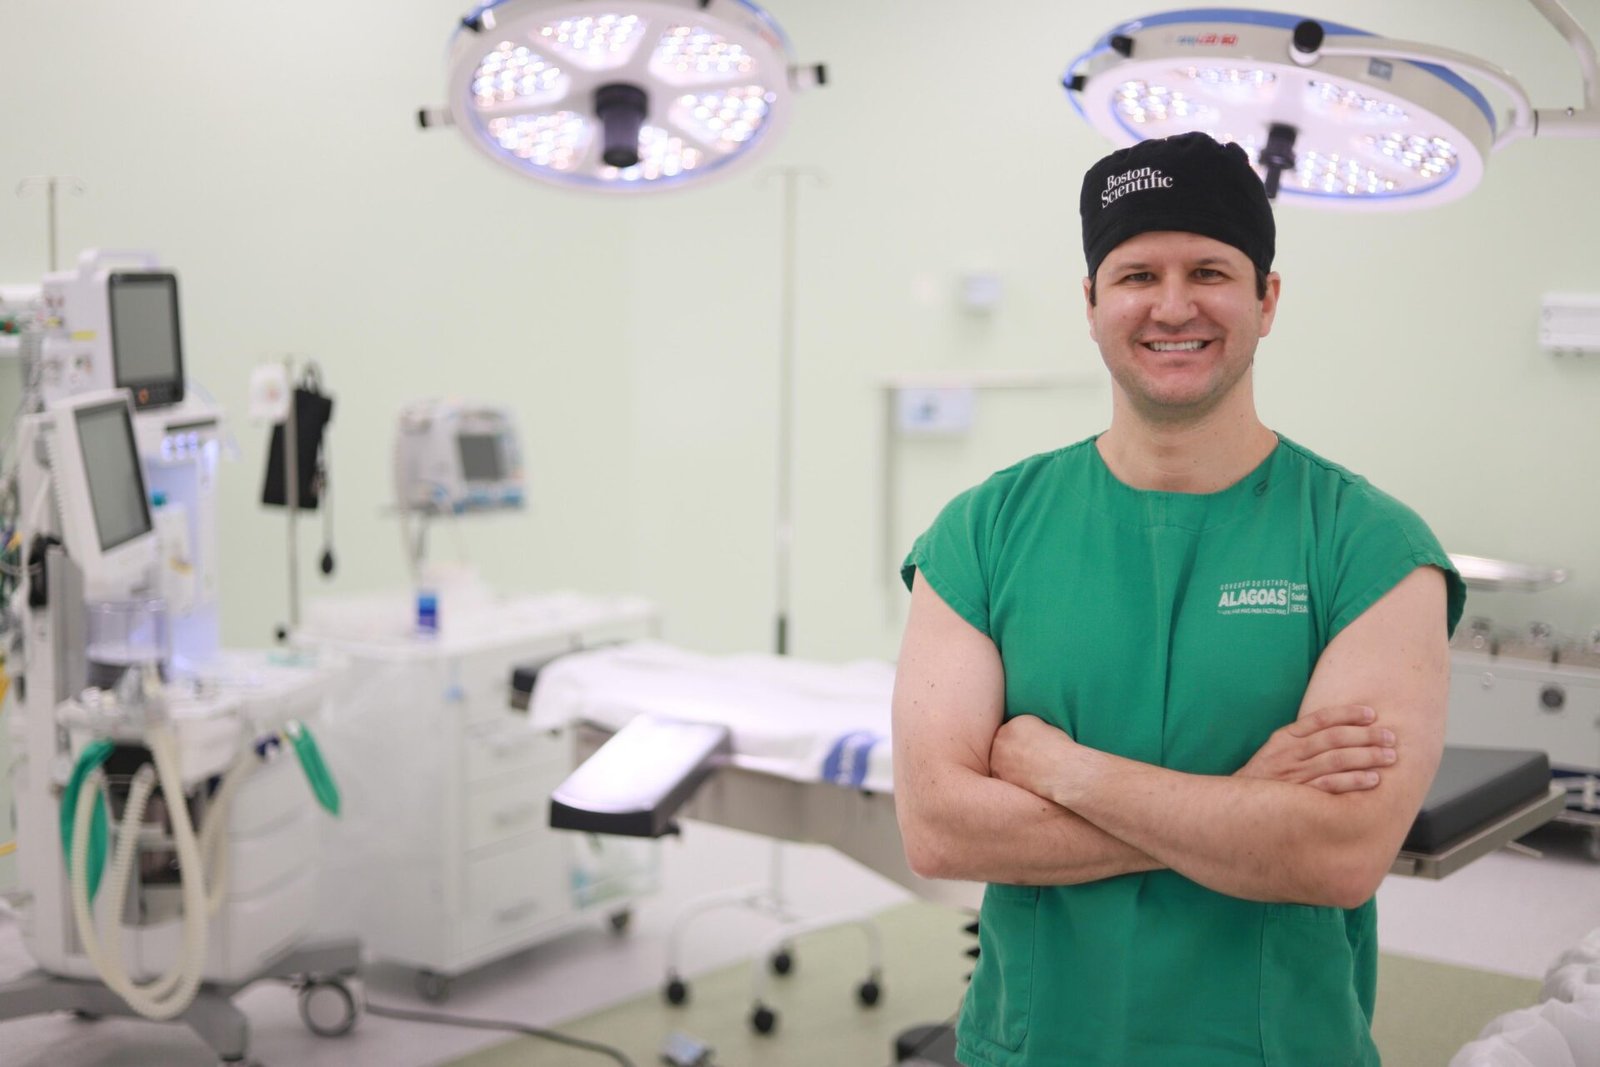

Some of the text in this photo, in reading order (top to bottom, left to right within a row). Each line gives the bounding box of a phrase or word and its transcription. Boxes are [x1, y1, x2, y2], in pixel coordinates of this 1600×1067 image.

[1101, 170, 1173, 208] Scientific
[1107, 167, 1151, 191] Boston
[1218, 588, 1287, 607] ALAGOAS
